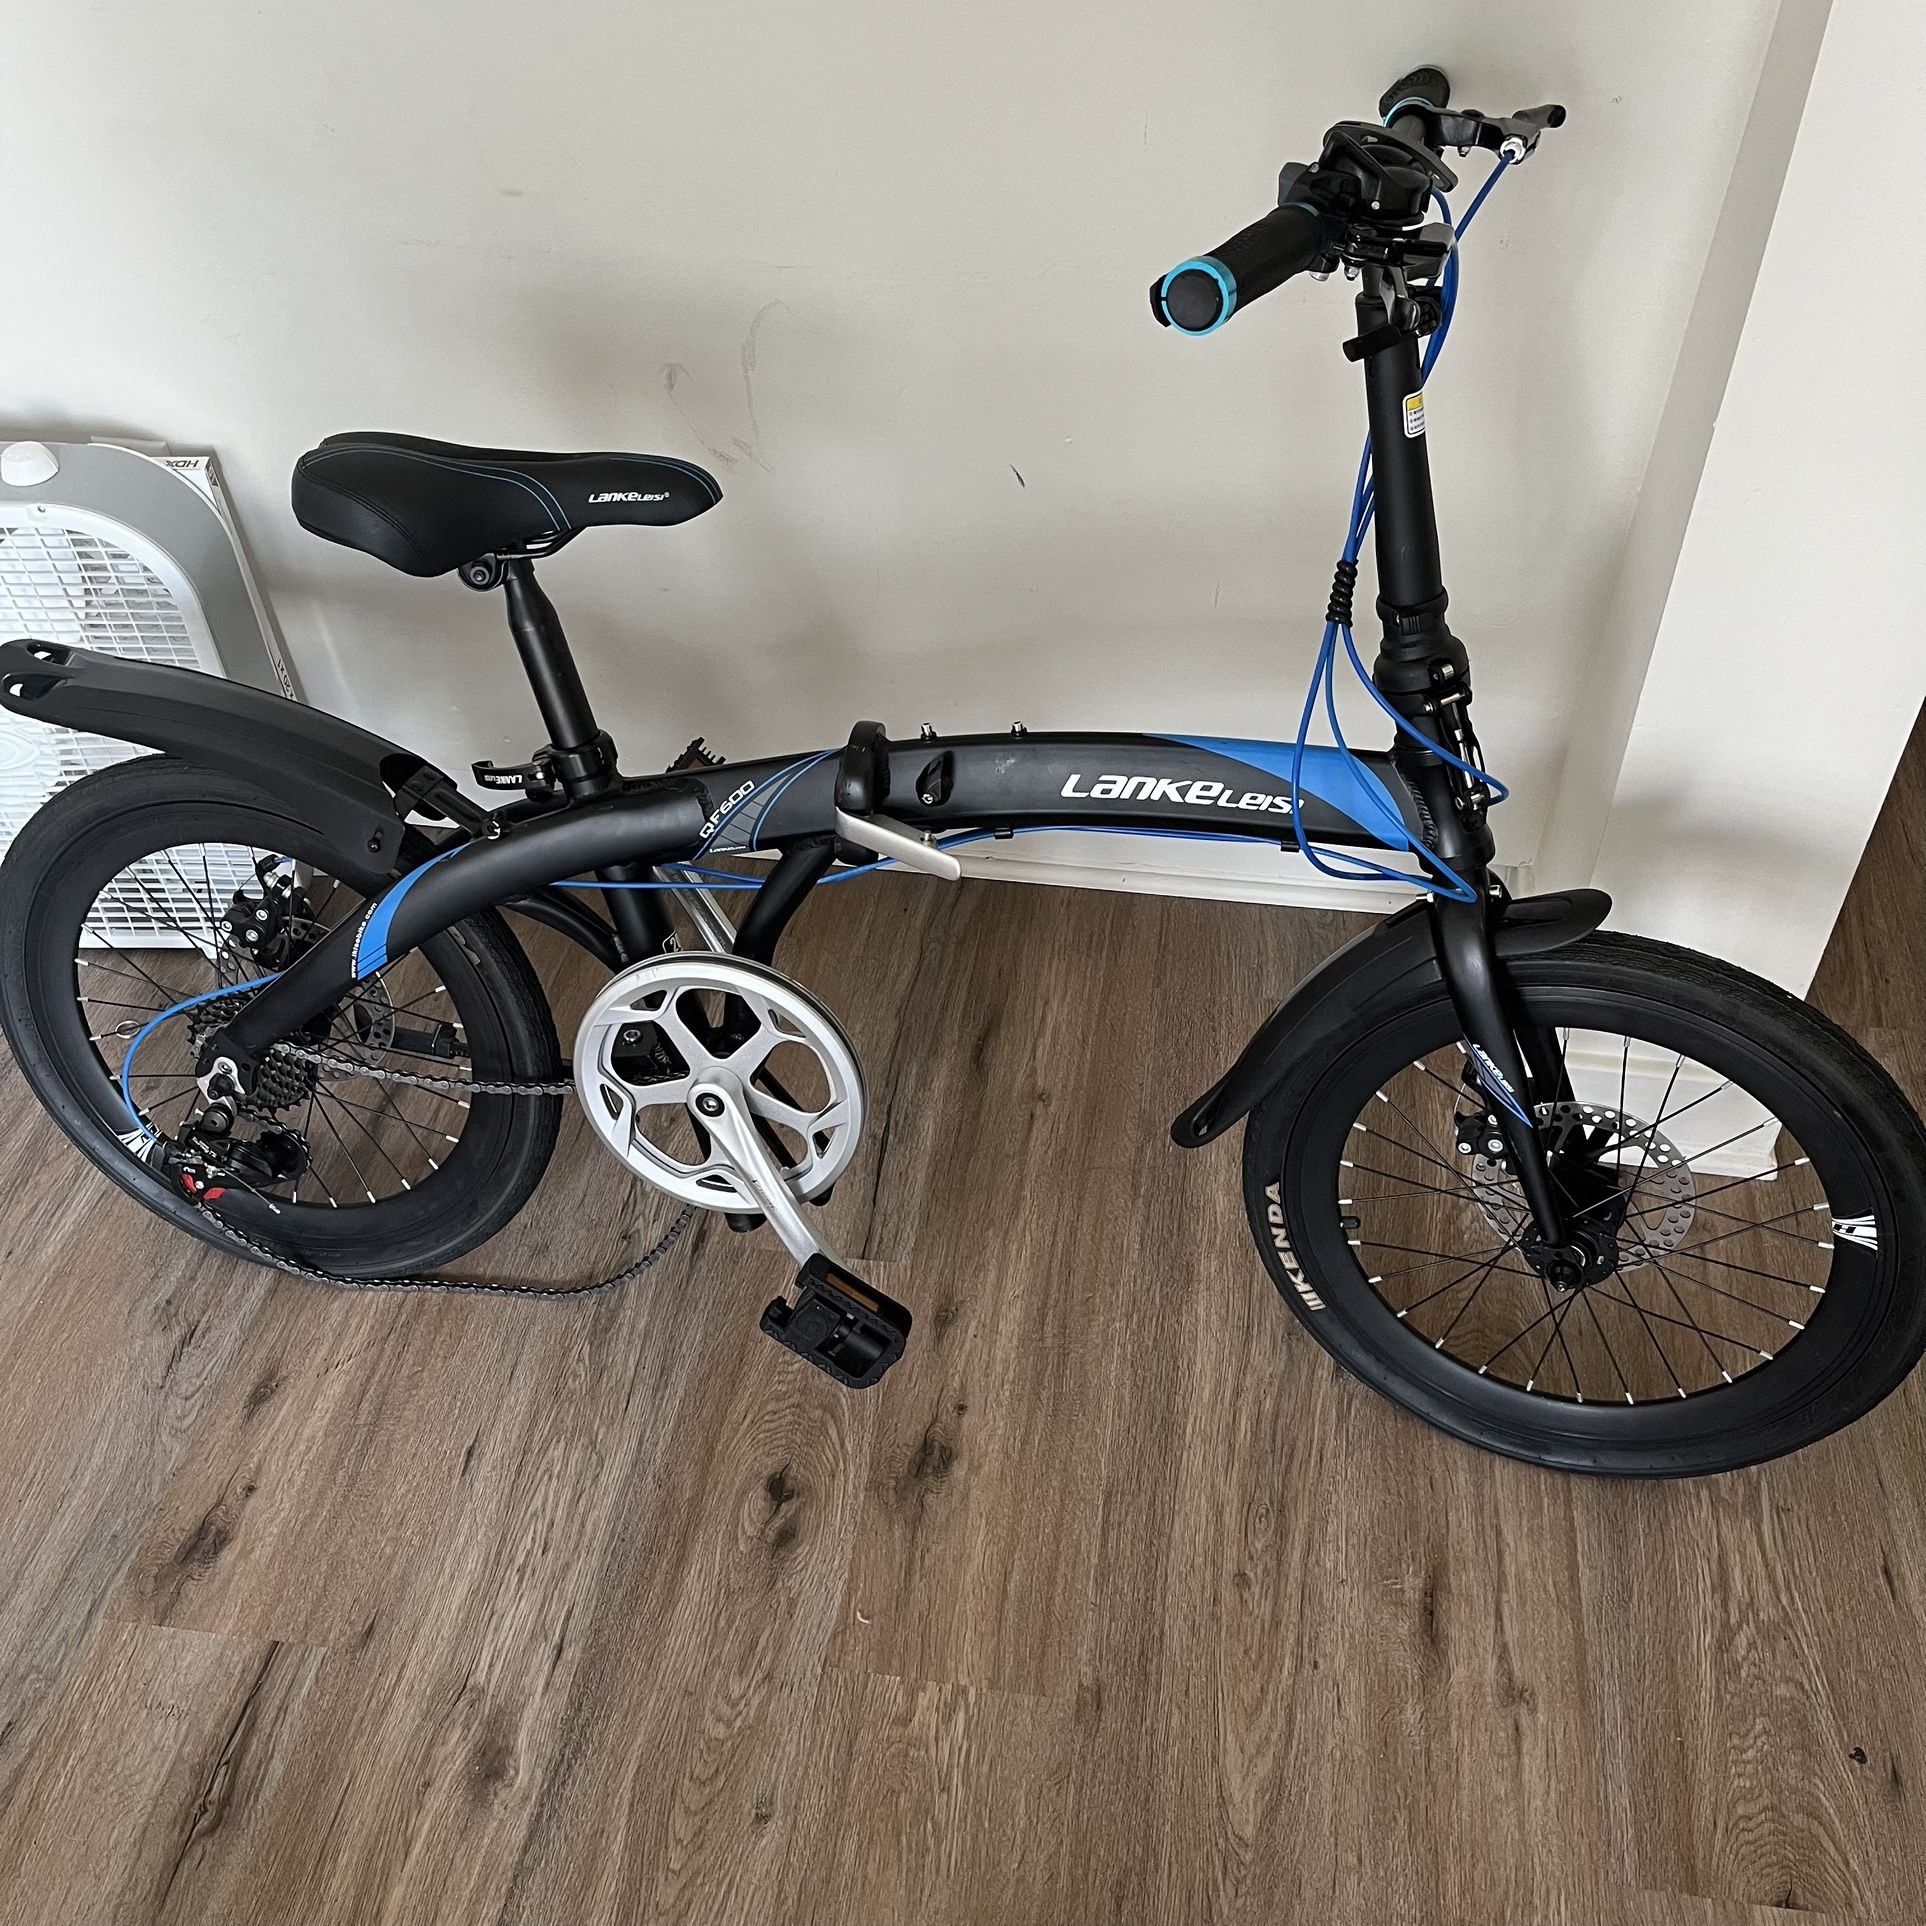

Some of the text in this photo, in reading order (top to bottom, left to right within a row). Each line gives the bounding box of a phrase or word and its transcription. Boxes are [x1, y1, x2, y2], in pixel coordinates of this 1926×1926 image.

[165, 460, 199, 468] HDX
[699, 780, 755, 839] QF600
[1264, 1181, 1314, 1293] KENDA
